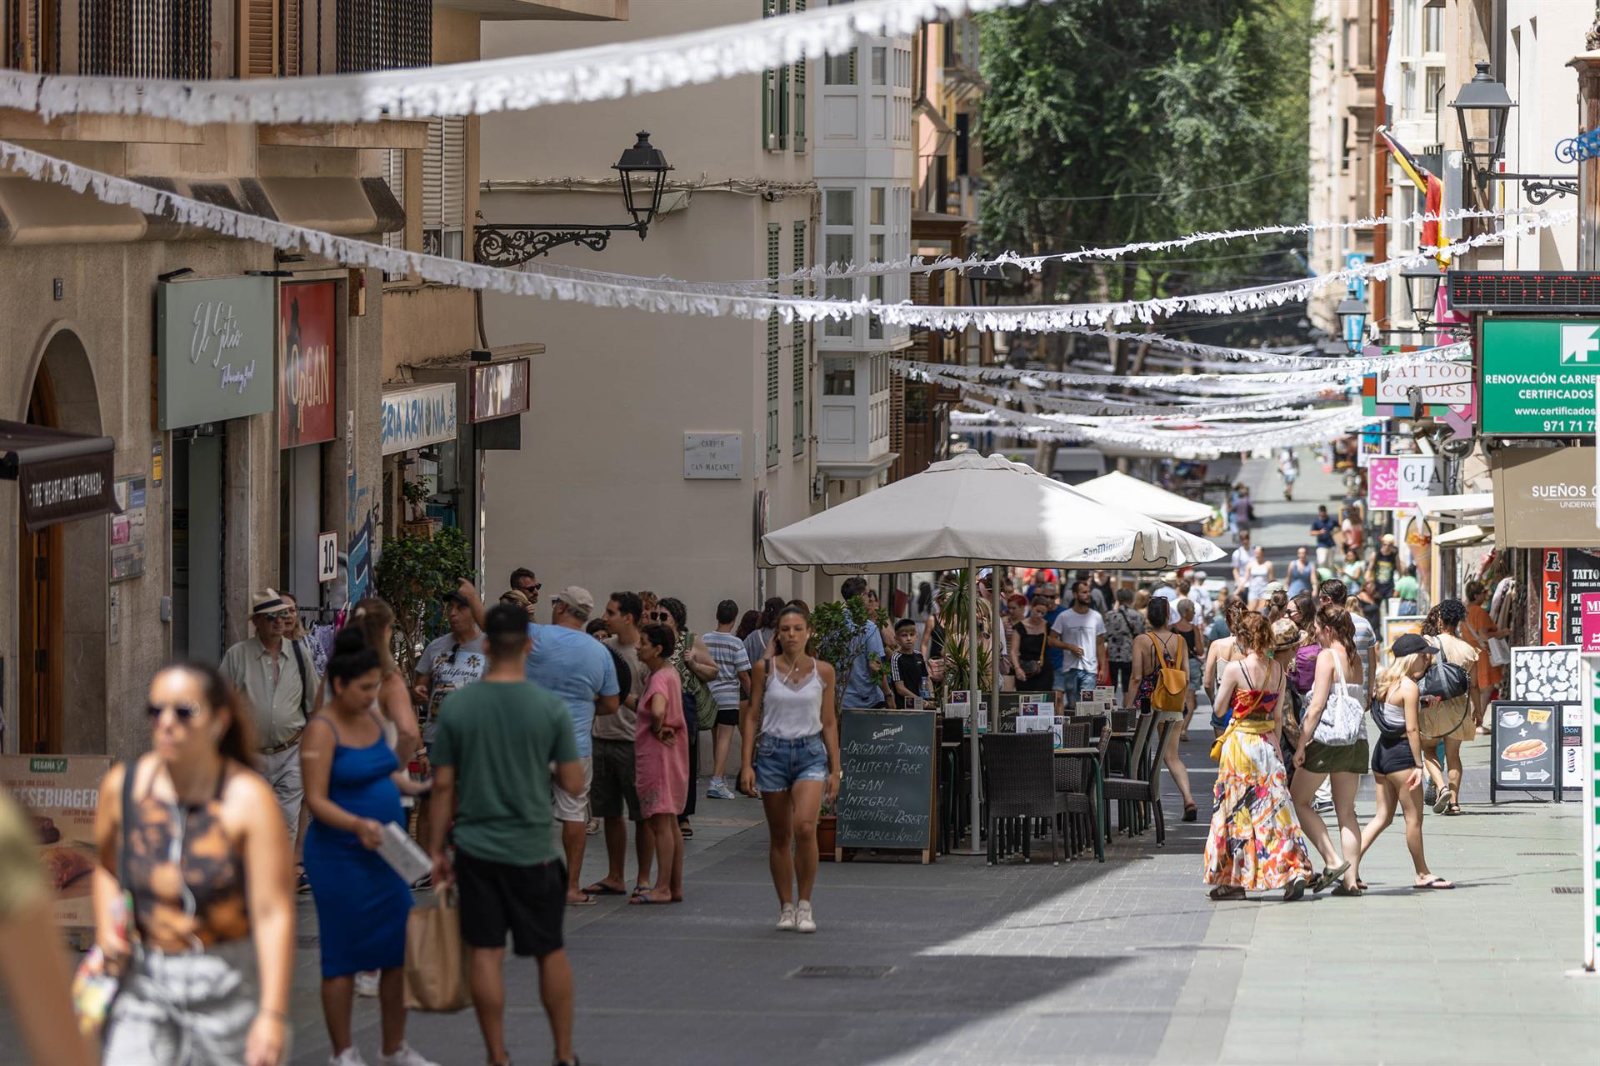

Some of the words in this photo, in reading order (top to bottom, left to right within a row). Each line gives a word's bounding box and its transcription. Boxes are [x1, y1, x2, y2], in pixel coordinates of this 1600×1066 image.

[1383, 365, 1467, 378] ATTOO
[1485, 372, 1557, 384] RENOVACIÓN
[1382, 384, 1467, 398] COORS
[1518, 389, 1594, 399] CERTIFICADOS
[1543, 420, 1565, 432] 971
[1569, 420, 1583, 432] 71
[705, 463, 734, 472] MAÇANET
[1403, 464, 1442, 484] GIA
[1532, 483, 1587, 497] SUEÑOS
[324, 540, 334, 575] 10
[872, 725, 903, 740] SanMiguel
